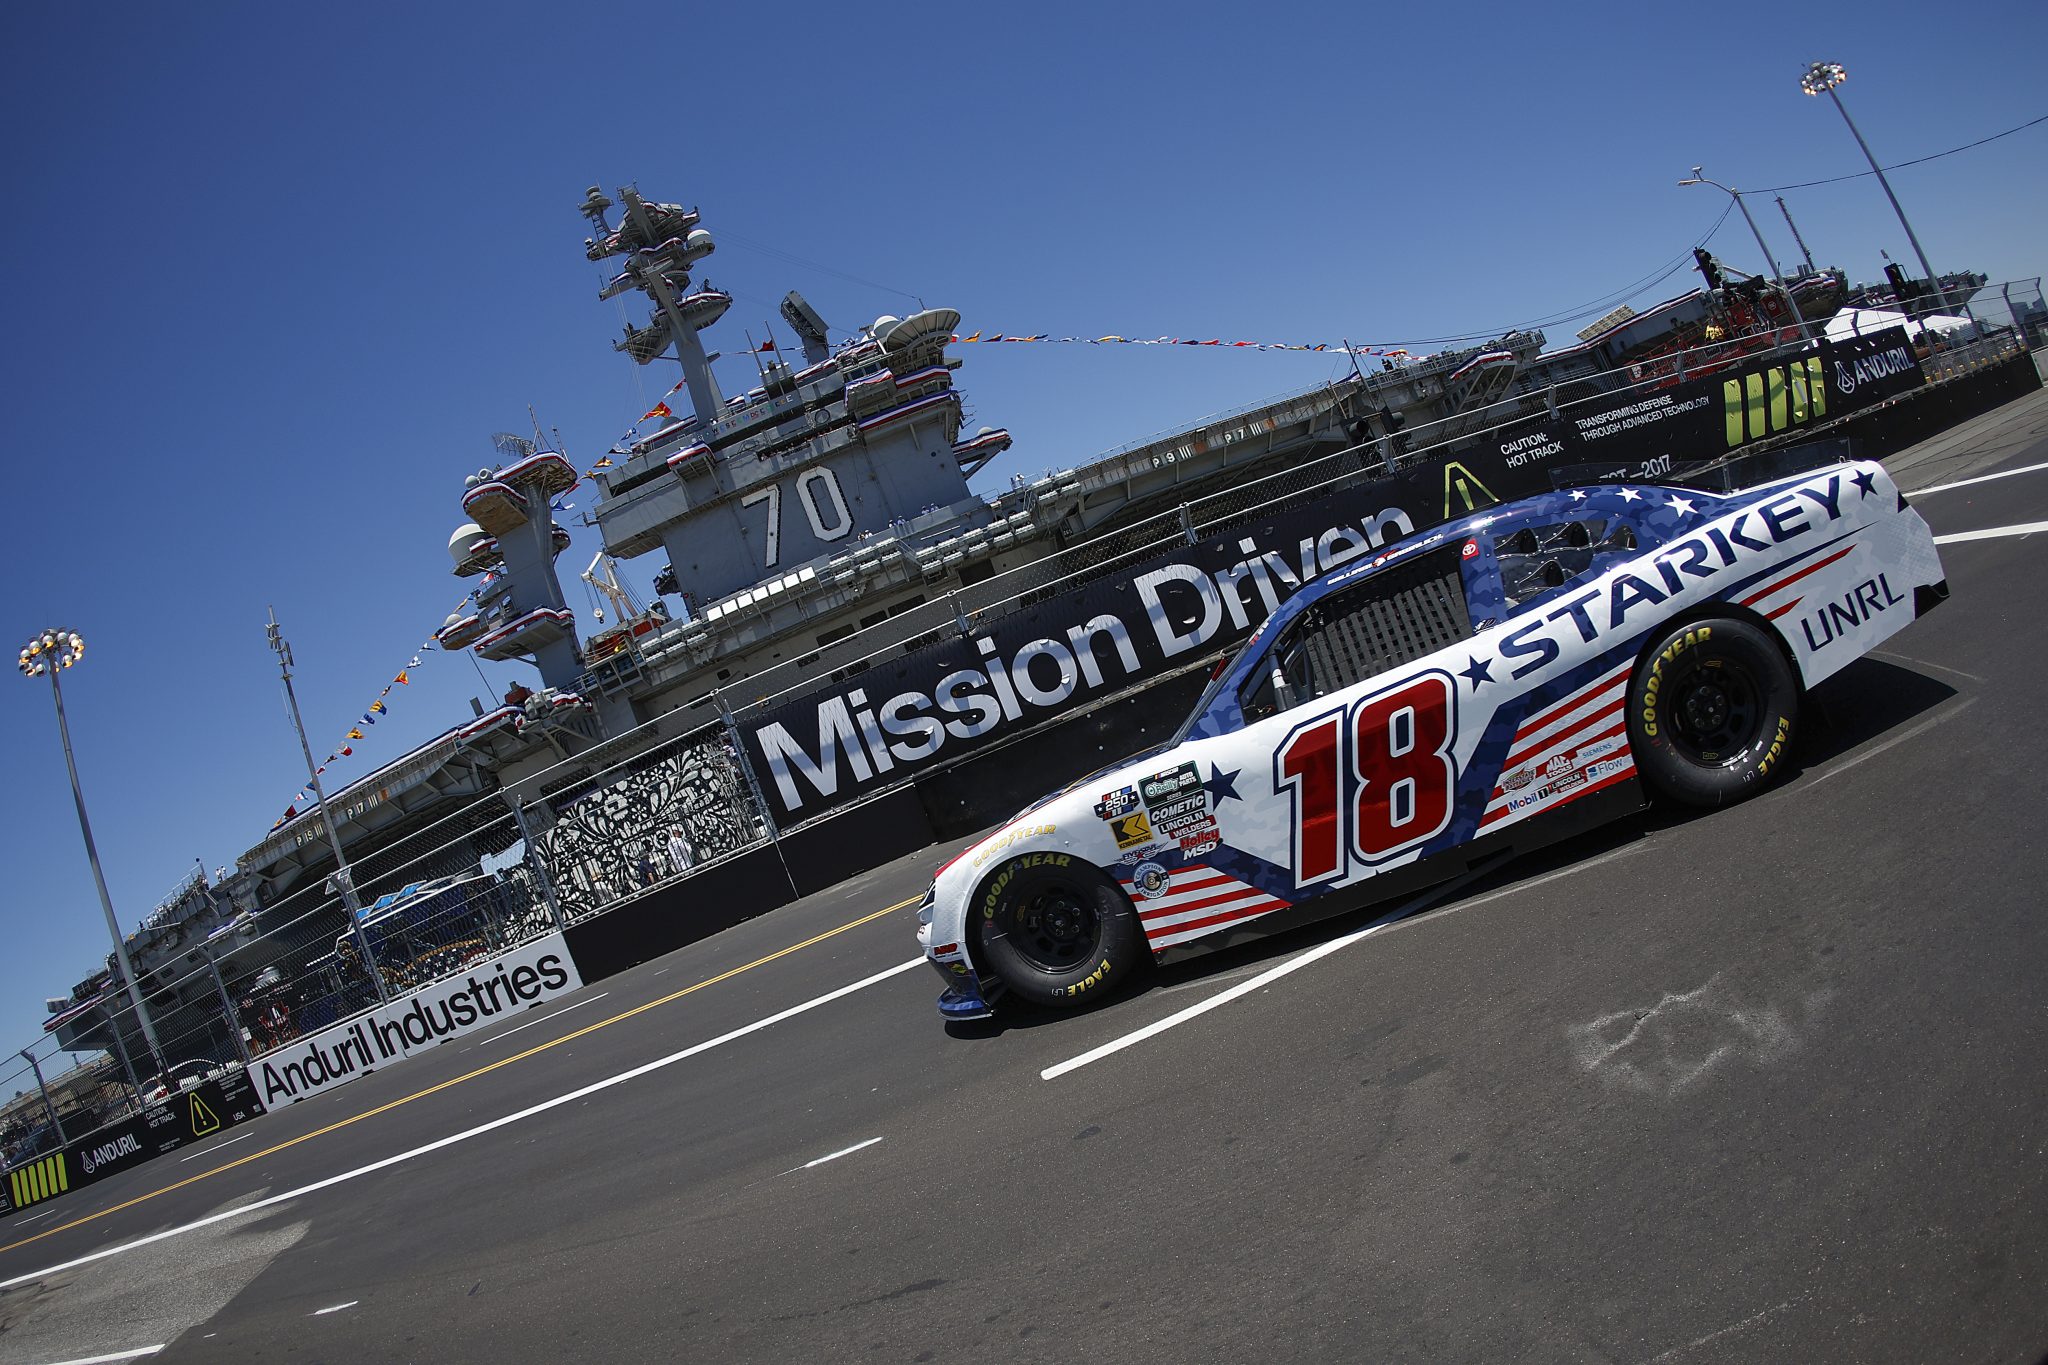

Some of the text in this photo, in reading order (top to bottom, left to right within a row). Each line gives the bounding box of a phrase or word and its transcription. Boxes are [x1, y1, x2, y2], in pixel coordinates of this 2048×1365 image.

[1854, 348, 1914, 386] ANDURIL
[1575, 394, 1673, 430] TRANSFORMING DEFENSE
[1581, 396, 1710, 442] THROUGH ADVANCED TECHNOLOGY
[1500, 432, 1549, 455] CAUTION:
[1506, 441, 1564, 469] HOT TRACK
[741, 465, 855, 568] 70
[1499, 474, 1843, 680] STARKEY
[1801, 573, 1905, 652] UNRL
[756, 508, 1414, 811] Mission Driven
[1643, 627, 1712, 737] GOODYEAR
[1582, 743, 1612, 758] SIEMENS
[1757, 716, 1790, 777] EAGLE
[1274, 670, 1457, 888] 18
[1547, 764, 1574, 779] TOOLS
[1597, 758, 1623, 775] Flow
[1552, 772, 1581, 791] LINCOLN
[1105, 795, 1129, 811] 250
[1151, 795, 1204, 822] COMETIC
[1509, 793, 1538, 811] Mobil
[1160, 811, 1205, 833] LINCOLN
[1174, 819, 1211, 838] WELDERS
[973, 824, 1056, 868] GOODYEAR
[1180, 828, 1220, 850] Holley
[1183, 841, 1217, 861] MSD
[1135, 863, 1163, 881] CHAMPION
[983, 853, 1071, 919] GOODYEAR
[1140, 882, 1169, 899] IRRIGATION
[1067, 959, 1112, 997] EAGLE
[261, 954, 568, 1104] Anduril Industries
[145, 1105, 169, 1120] CAUTION:
[149, 1111, 177, 1129] HOT TRACK
[233, 1111, 246, 1121] USA
[93, 1133, 142, 1167] ANDURIL
